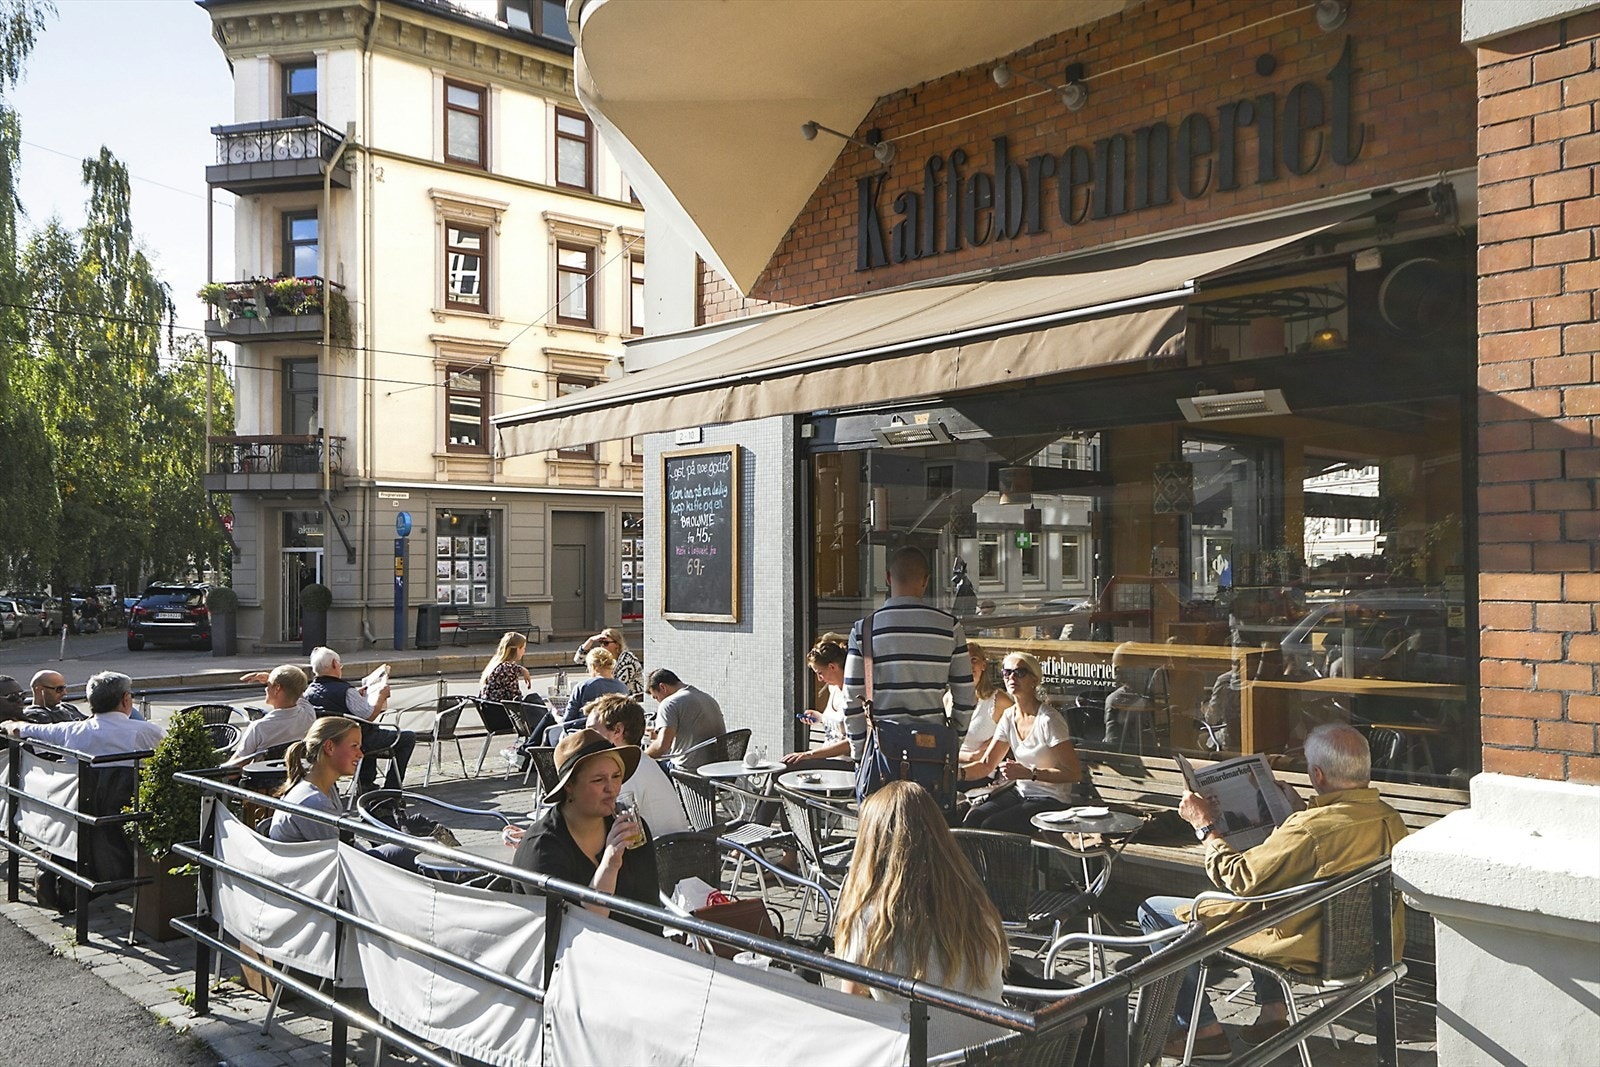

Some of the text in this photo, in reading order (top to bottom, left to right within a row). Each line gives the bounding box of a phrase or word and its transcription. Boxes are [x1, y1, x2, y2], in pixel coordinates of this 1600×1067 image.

[855, 34, 1365, 272] Kaffebrenneriet
[680, 513, 716, 528] BROWNIE
[1034, 656, 1118, 679] affebrenneriet
[1060, 677, 1075, 685] FOR
[1093, 680, 1117, 688] KAFFE
